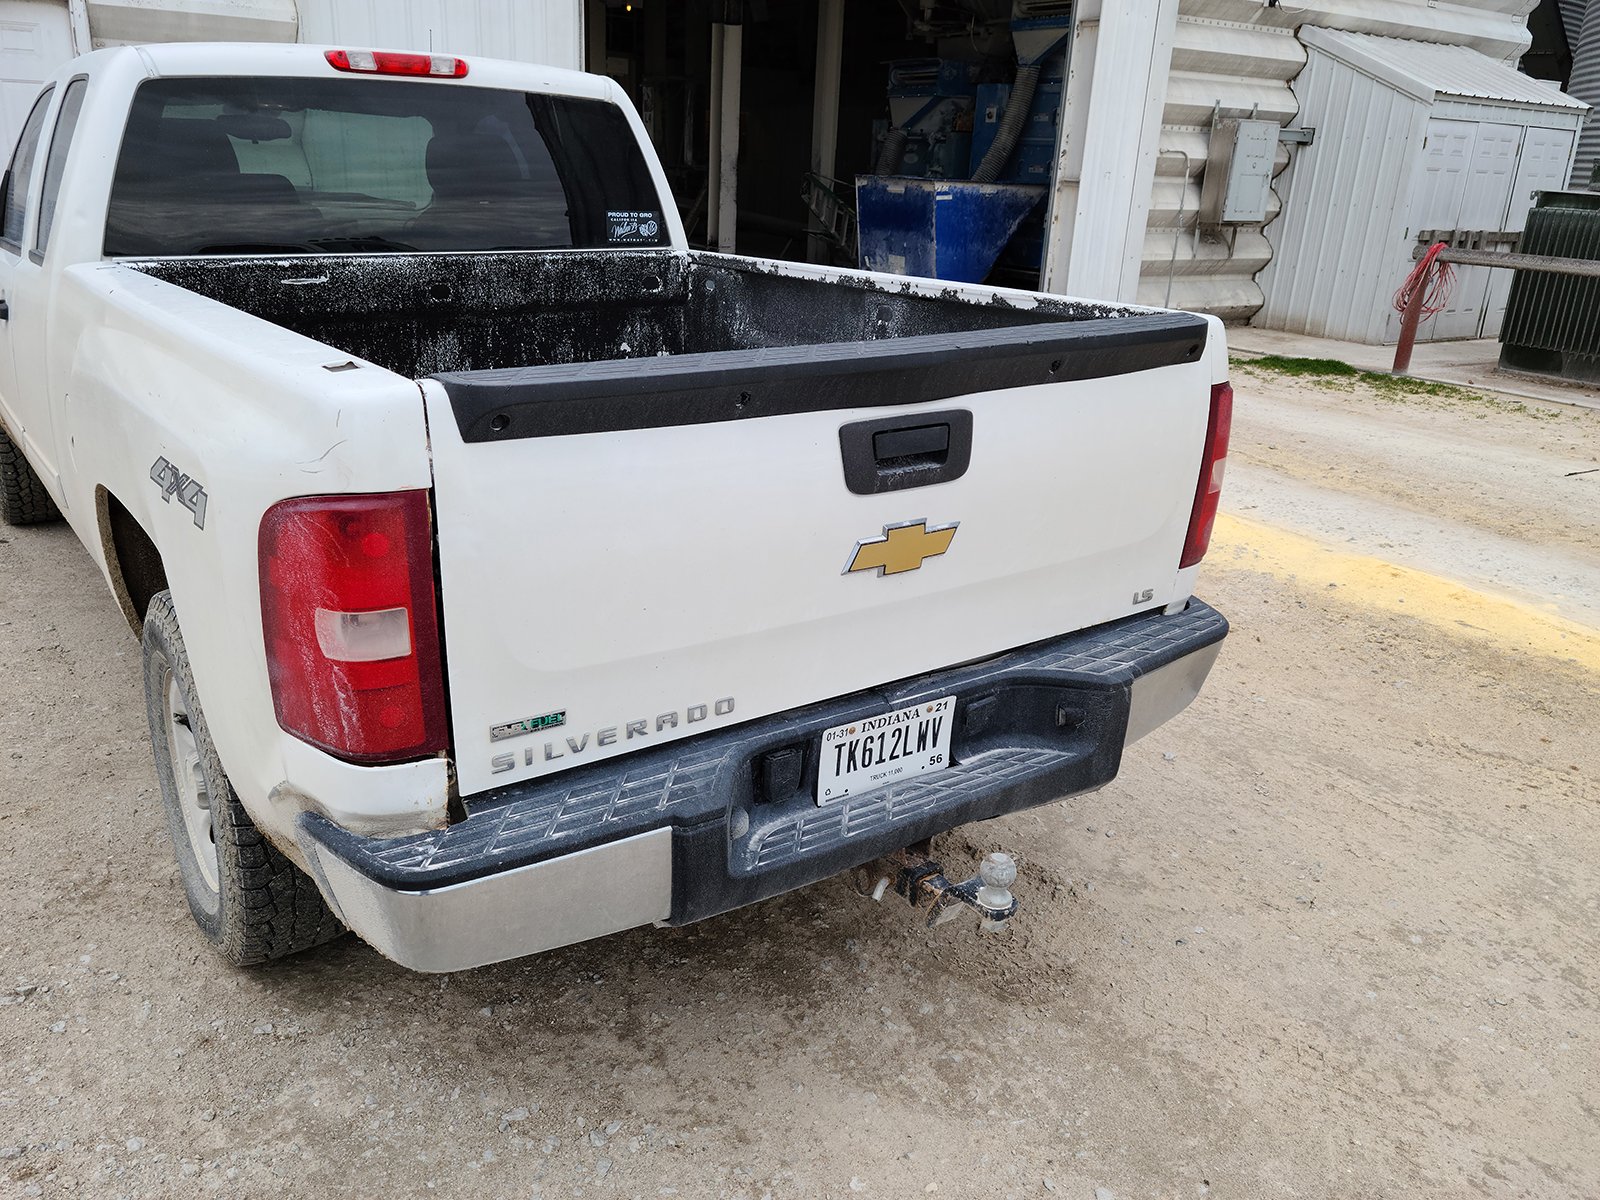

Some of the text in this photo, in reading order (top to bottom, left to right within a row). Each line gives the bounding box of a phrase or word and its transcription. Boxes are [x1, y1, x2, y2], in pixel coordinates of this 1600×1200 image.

[1132, 589, 1154, 605] LS
[934, 701, 948, 712] 21
[861, 708, 920, 733] INDIANA
[491, 696, 735, 774] SILVERADO
[826, 728, 849, 741] 01-31
[834, 716, 943, 777] TK612LWV
[929, 754, 943, 765] 56
[870, 771, 888, 781] TRUCK
